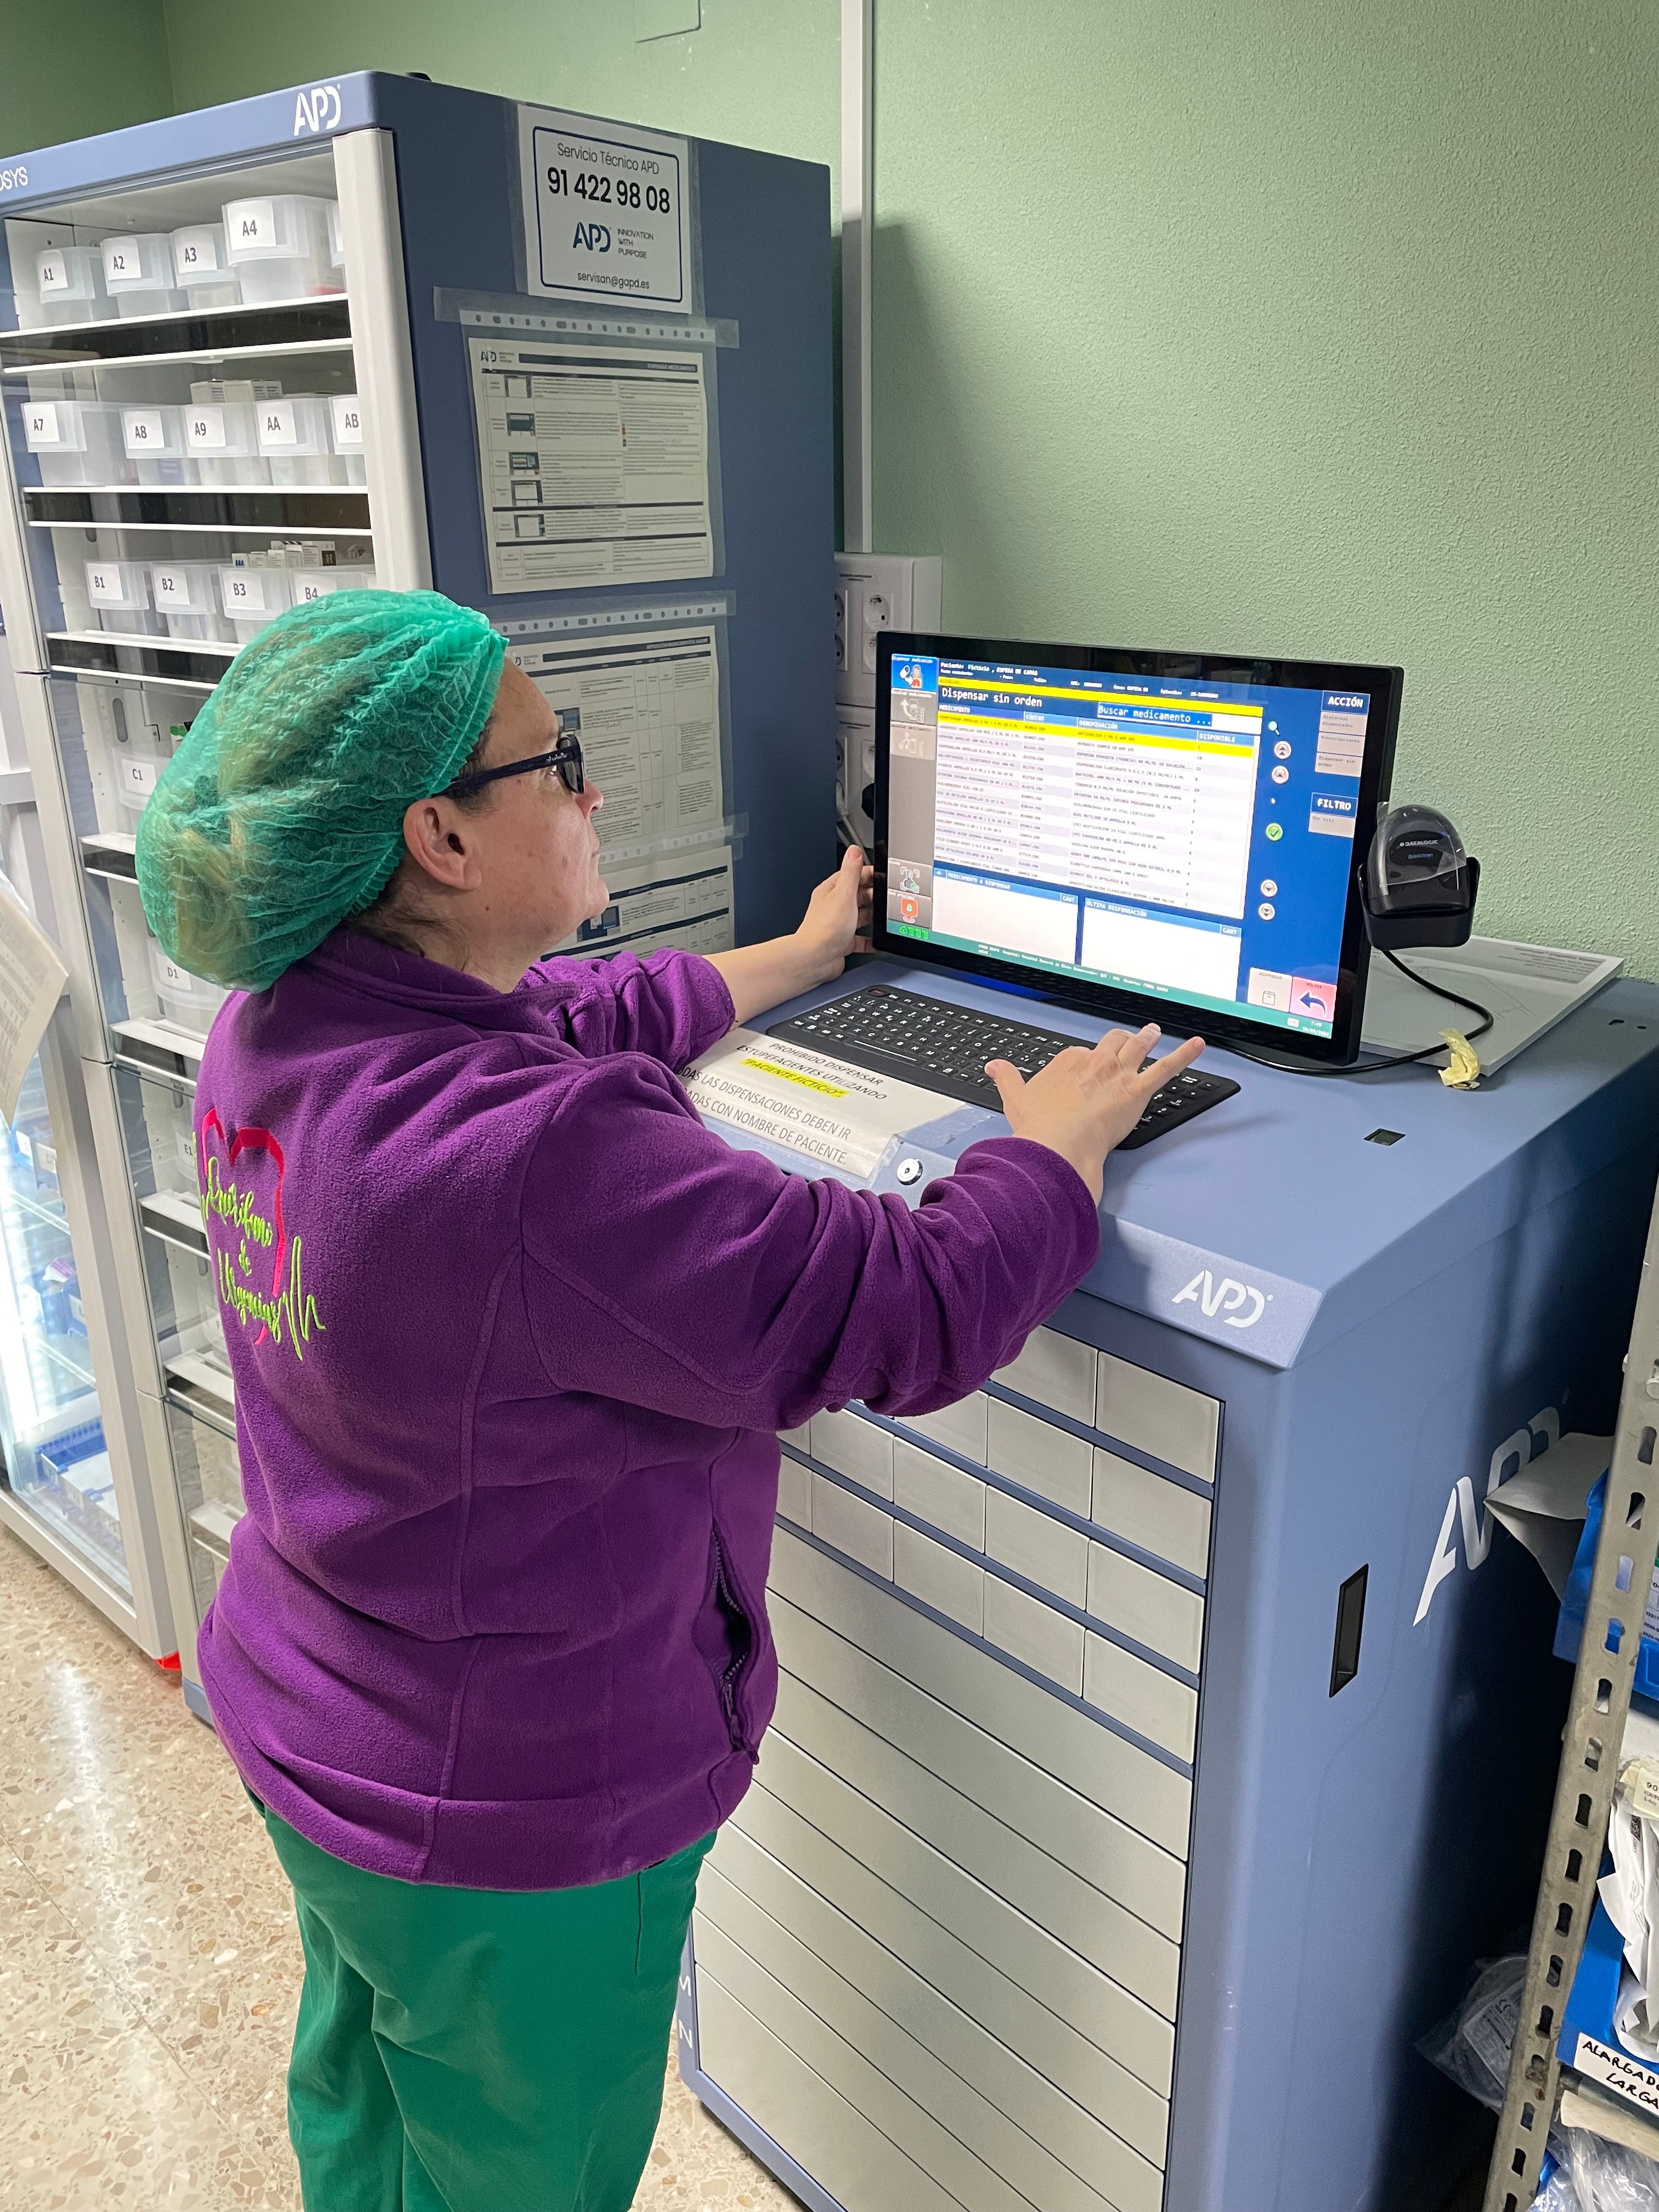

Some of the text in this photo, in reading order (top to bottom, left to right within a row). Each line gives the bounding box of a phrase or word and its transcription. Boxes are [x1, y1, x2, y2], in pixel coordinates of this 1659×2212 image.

[557, 143, 659, 176] Servicio Técnico APD
[548, 167, 670, 213] 91 422 98 08
[242, 220, 257, 236] A4
[618, 228, 653, 240] INNOVATION
[573, 222, 611, 252] APD
[618, 238, 634, 246] WITH
[184, 247, 196, 263] A3
[618, 247, 647, 258] PURPOSE
[113, 256, 125, 270] A2
[44, 267, 54, 282] A1
[578, 271, 650, 290] servisan@gapd.es
[33, 418, 43, 432] A7
[194, 422, 206, 436] A9
[267, 417, 281, 431] AA
[345, 414, 359, 429] AB
[134, 425, 147, 439] A8
[94, 575, 105, 589] B1
[162, 578, 174, 592] B2
[233, 583, 246, 596] B3
[304, 587, 318, 600] B4
[941, 687, 1042, 707] Dispensar sin orden
[1327, 693, 1364, 708] ACCIÓN
[1098, 704, 1129, 716] Buscar
[1132, 708, 1192, 723] medicamento
[939, 704, 1236, 743] MEDICAMENTO CÓDIGO DENOMINACIÓN DISPONIBLE
[132, 768, 144, 781] C1
[1316, 797, 1352, 811] FILTRO
[947, 872, 978, 883] MEDICAMENTO
[985, 879, 1011, 890] DISPENSAR
[1062, 895, 1075, 903] CANT
[1086, 899, 1237, 935] ÚLTIMA DISPENSACIÓN CANT
[167, 967, 179, 979] D1
[770, 1043, 883, 1085] PROHIBIDO DISPENSAR
[736, 1045, 887, 1100] ESTUPEFACIENTES UTILIZANDO
[701, 1074, 718, 1088] LAS
[719, 1081, 803, 1120] DISPENSACIONES
[802, 1113, 840, 1135] DEBEN
[838, 1126, 851, 1140] IR
[711, 1101, 733, 1118] CON
[733, 1109, 780, 1136] NOMBRE
[779, 1127, 796, 1142] DE
[795, 1136, 848, 1165] PACIENTE.
[1172, 1269, 1266, 1328] APD
[679, 2019, 693, 2049] N
